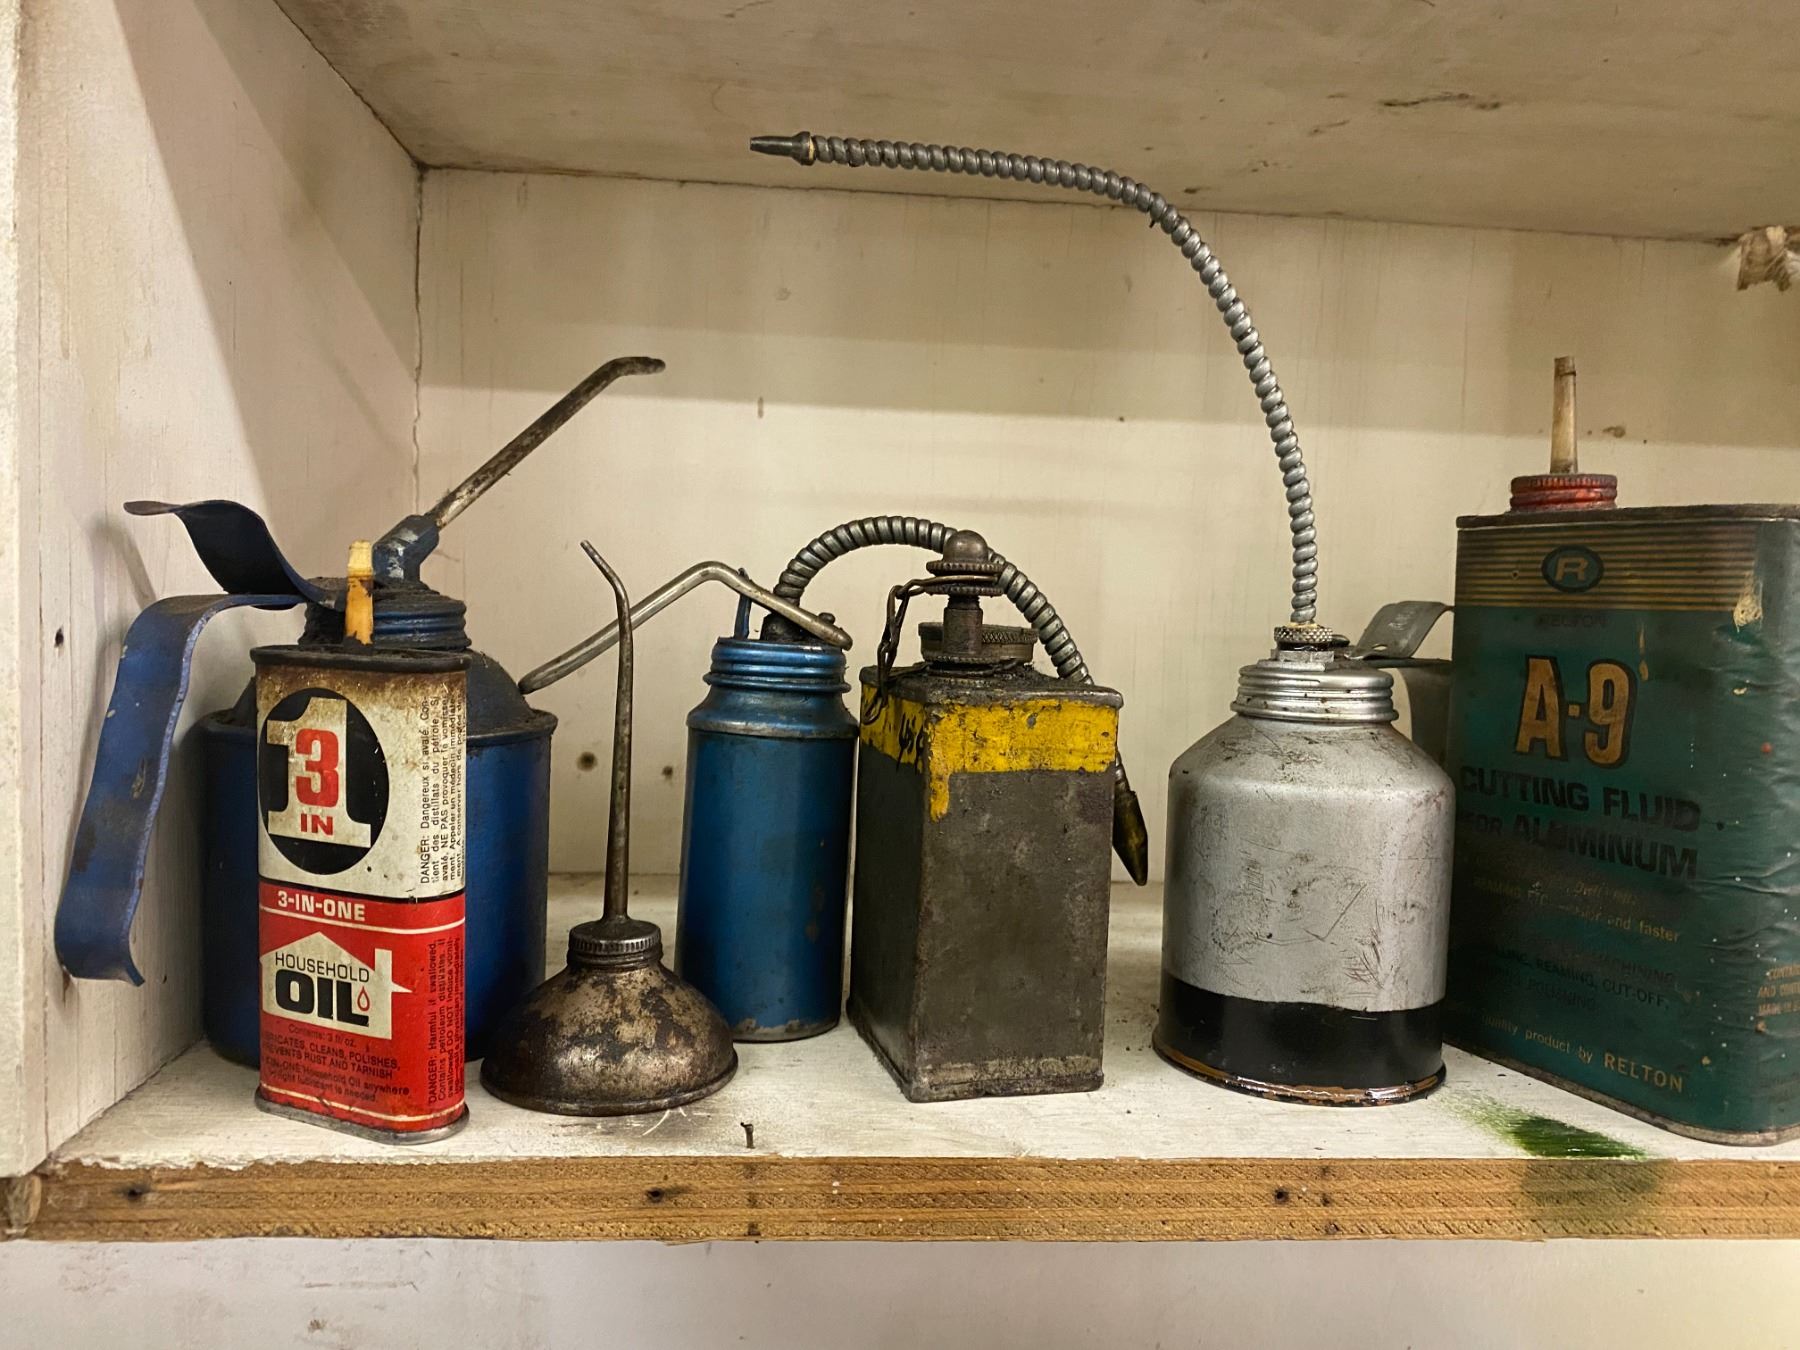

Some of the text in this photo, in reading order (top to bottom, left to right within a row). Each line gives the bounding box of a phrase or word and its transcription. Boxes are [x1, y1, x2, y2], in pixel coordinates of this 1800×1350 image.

[1554, 556, 1590, 582] R
[420, 696, 429, 721] Con-
[1514, 655, 1636, 769] A-9
[295, 727, 339, 808] 3
[421, 762, 429, 770] si
[431, 762, 440, 775] du
[441, 756, 450, 806] provoquer
[420, 776, 431, 829] Dangereux
[431, 783, 440, 826] distillats
[449, 797, 456, 810] un
[1458, 765, 1701, 833] CUTTING FLUID
[300, 813, 333, 836] IN
[441, 809, 449, 830] PAS
[449, 813, 457, 850] Appeler
[431, 834, 440, 852] des
[441, 834, 448, 849] NE
[1512, 813, 1698, 878] ALUMINUM
[420, 835, 430, 884] DANGER:
[277, 890, 366, 922] 3-IN-ONE
[1638, 919, 1681, 944] faster
[275, 951, 370, 983] HOUSEHOLD
[275, 969, 369, 1027] OIL
[446, 969, 454, 1002] induce
[1602, 977, 1670, 1010] CUT-OFF,
[427, 1012, 437, 1050] Harmful
[438, 1006, 447, 1054] petroleum
[446, 1005, 454, 1027] NOT
[446, 1030, 454, 1047] DO
[304, 1051, 327, 1065] RUST
[330, 1058, 348, 1070] AND
[351, 1062, 393, 1079] TARNISH
[349, 1051, 401, 1071] POLISHES,
[1524, 1029, 1571, 1055] product
[1577, 1045, 1594, 1065] by
[1603, 1051, 1684, 1093] RELTON
[363, 1082, 410, 1096] anywhere
[427, 1055, 437, 1105] DANGER:
[437, 1058, 446, 1101] Contains
